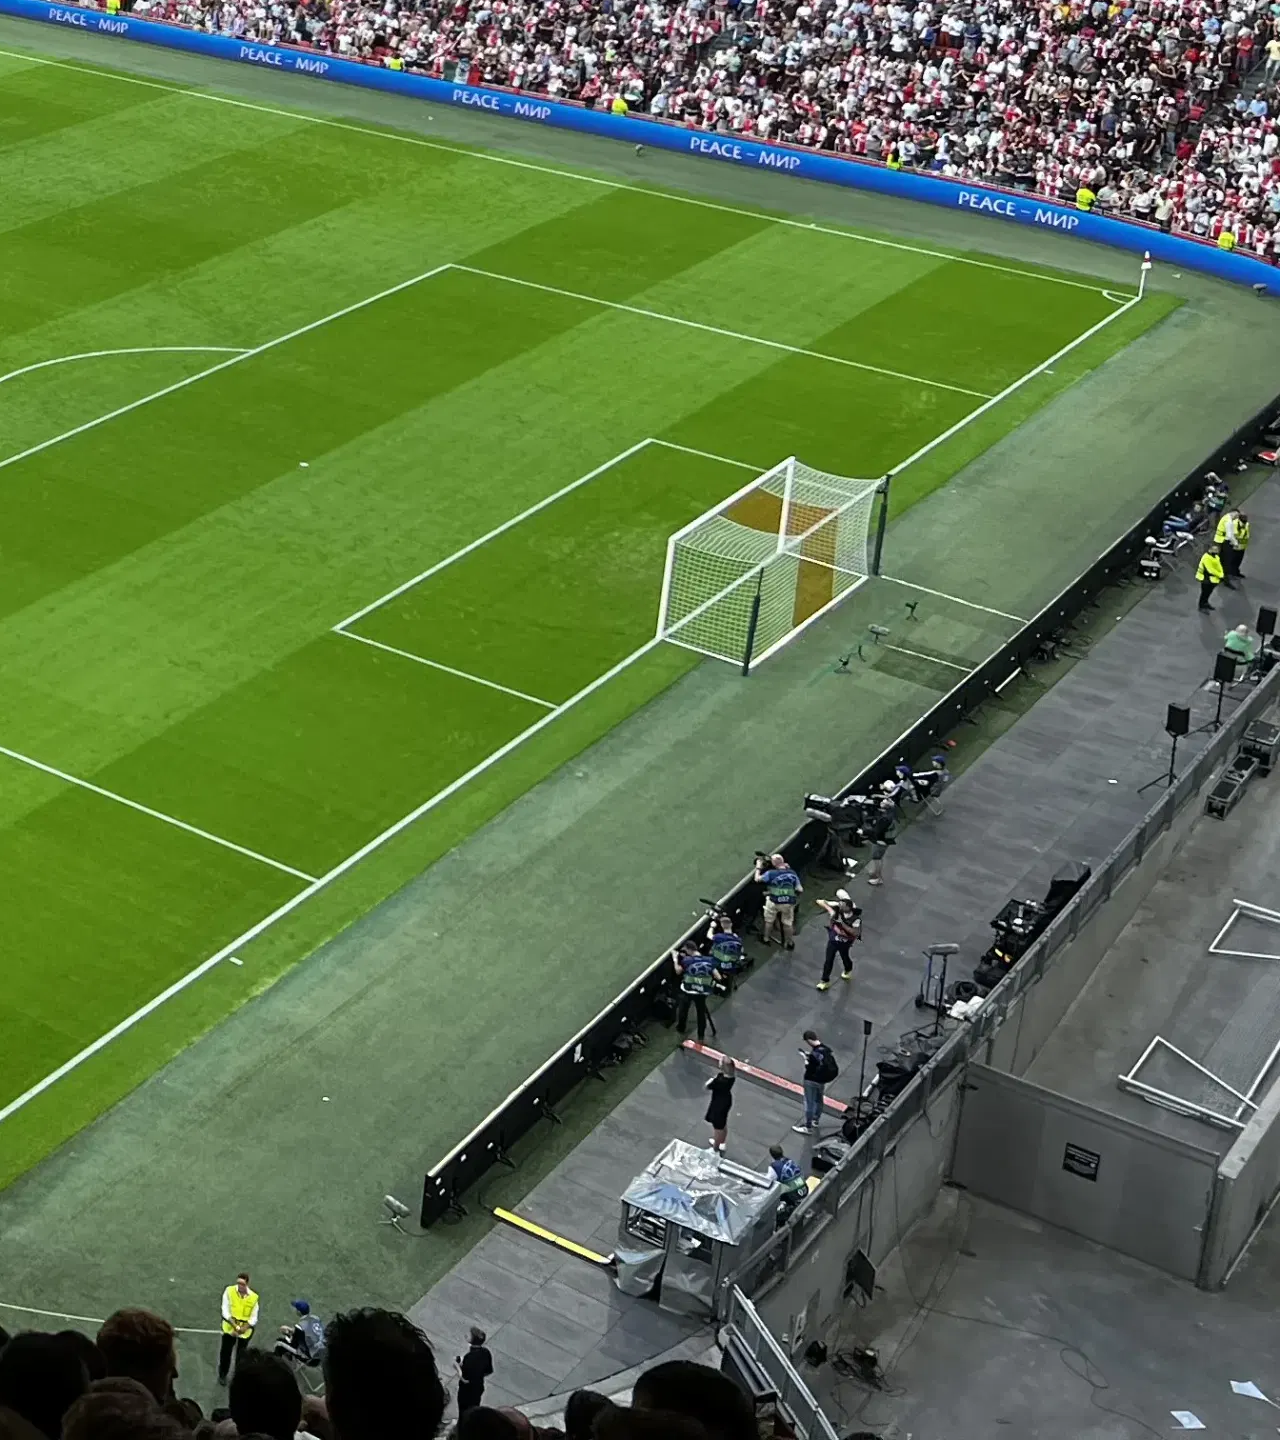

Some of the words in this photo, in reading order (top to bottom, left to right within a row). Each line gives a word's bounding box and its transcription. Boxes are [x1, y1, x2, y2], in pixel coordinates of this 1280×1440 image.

[48, 7, 87, 26] PEACE
[240, 46, 282, 65] PEACE
[453, 90, 500, 110] PEACE
[690, 137, 742, 159] PEACE
[958, 191, 1016, 217] PEACE
